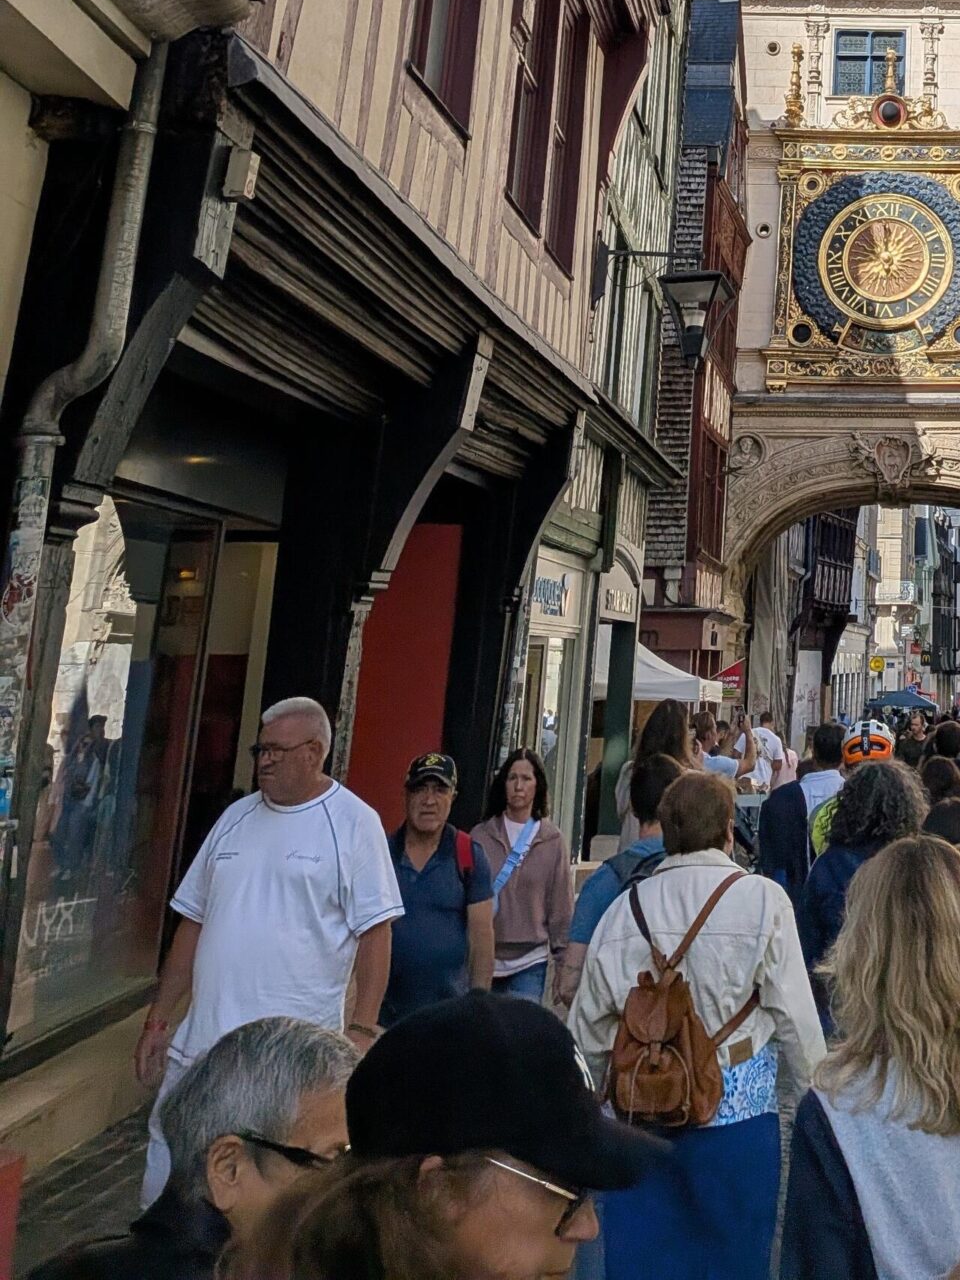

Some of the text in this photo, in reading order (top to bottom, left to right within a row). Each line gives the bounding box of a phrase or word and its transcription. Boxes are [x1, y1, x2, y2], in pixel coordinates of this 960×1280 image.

[851, 207, 872, 226] XI
[876, 203, 900, 217] XII
[909, 211, 918, 223] I
[835, 225, 851, 241] X
[925, 230, 939, 241] II
[828, 250, 842, 268] IX
[931, 253, 945, 268] III
[830, 272, 849, 299] VIII
[920, 275, 940, 297] IIII
[847, 296, 867, 314] VII
[875, 304, 893, 317] VI
[907, 298, 919, 313] V
